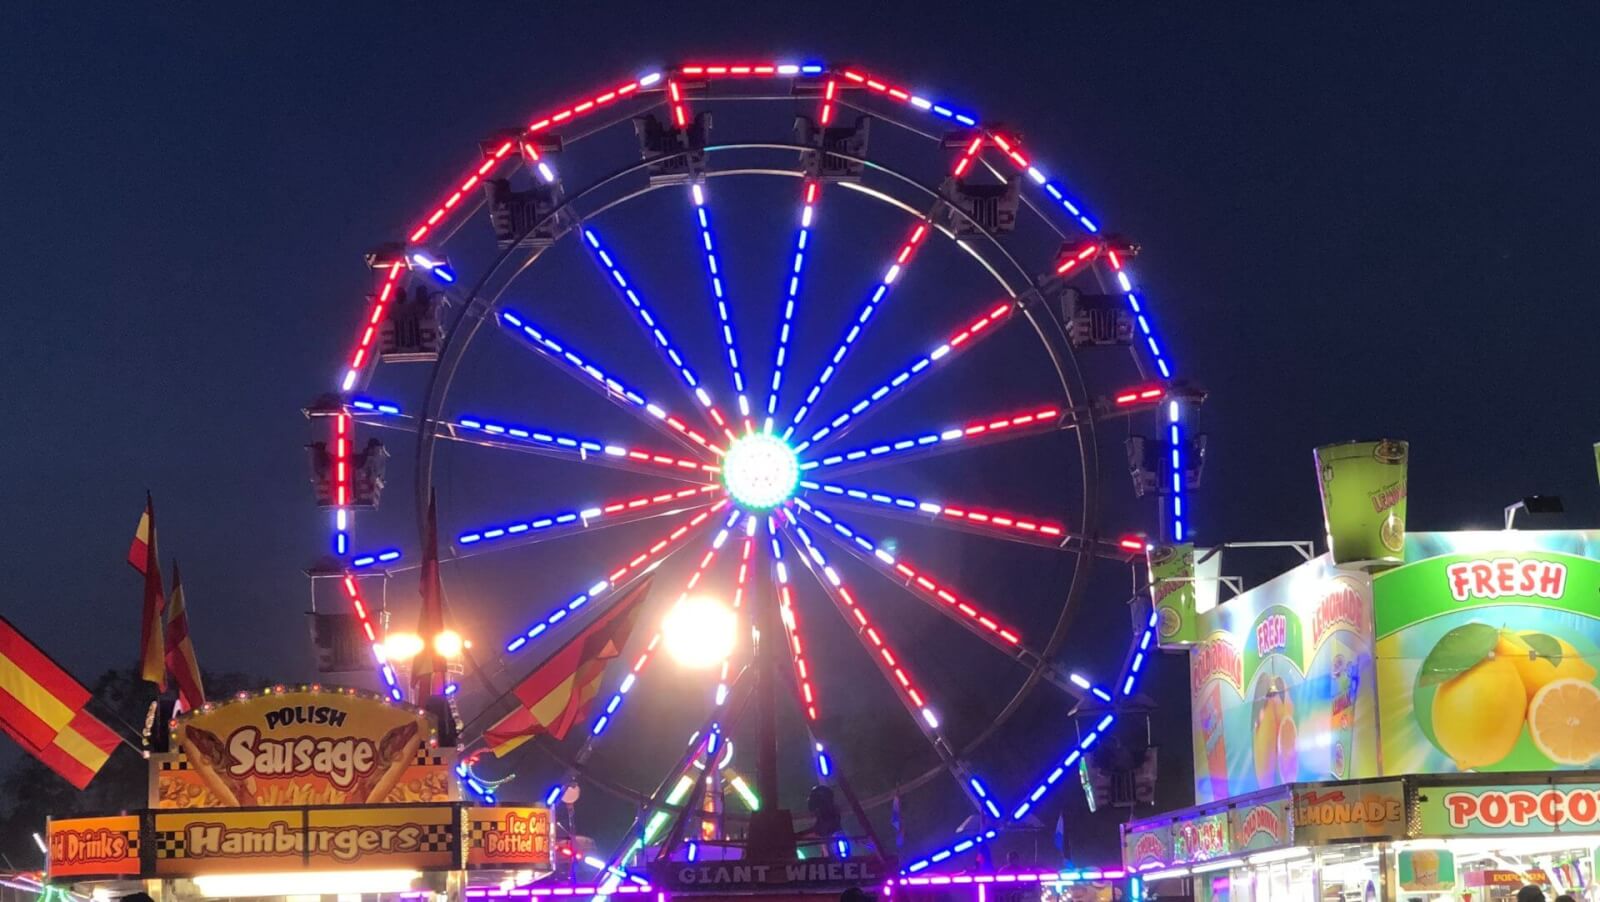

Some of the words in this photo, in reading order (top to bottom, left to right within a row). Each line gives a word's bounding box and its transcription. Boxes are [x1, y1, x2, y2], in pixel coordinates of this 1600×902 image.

[1450, 561, 1563, 598] FRESH
[1257, 614, 1287, 656] FRESH
[264, 705, 347, 730] POLISH
[228, 728, 376, 788] Sausage
[1448, 791, 1600, 826] POPCO
[509, 816, 527, 834] Ice
[67, 831, 125, 861] Drinks
[187, 824, 422, 859] Hamburgers
[488, 833, 532, 853] Bottled
[678, 865, 770, 884] GIANT
[785, 862, 876, 882] WHEEL
